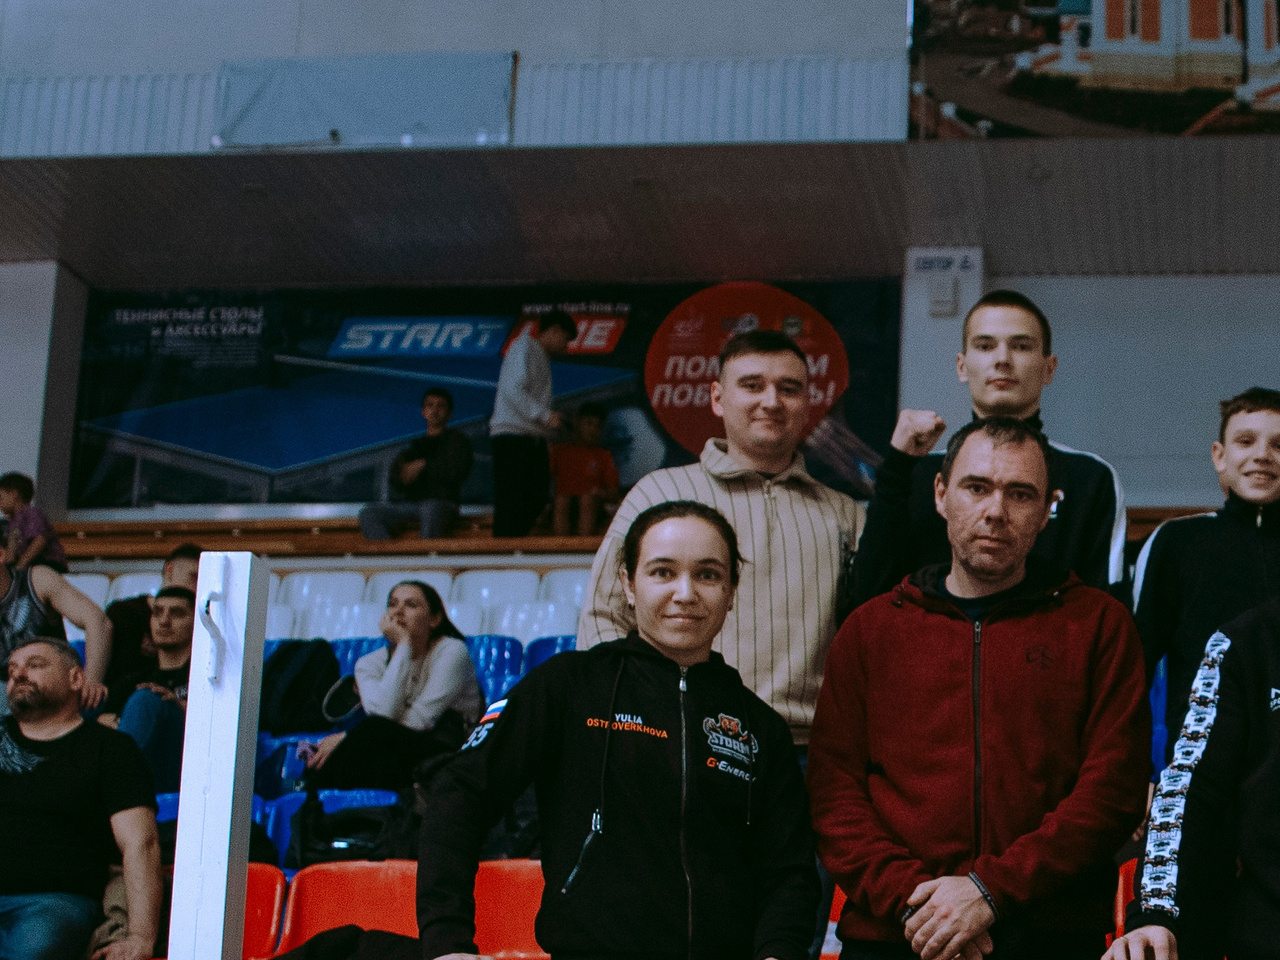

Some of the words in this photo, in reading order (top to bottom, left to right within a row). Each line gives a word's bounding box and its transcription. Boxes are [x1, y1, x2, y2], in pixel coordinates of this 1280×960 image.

[340, 322, 501, 350] START
[614, 713, 643, 724] YULIA
[711, 732, 750, 755] STORM
